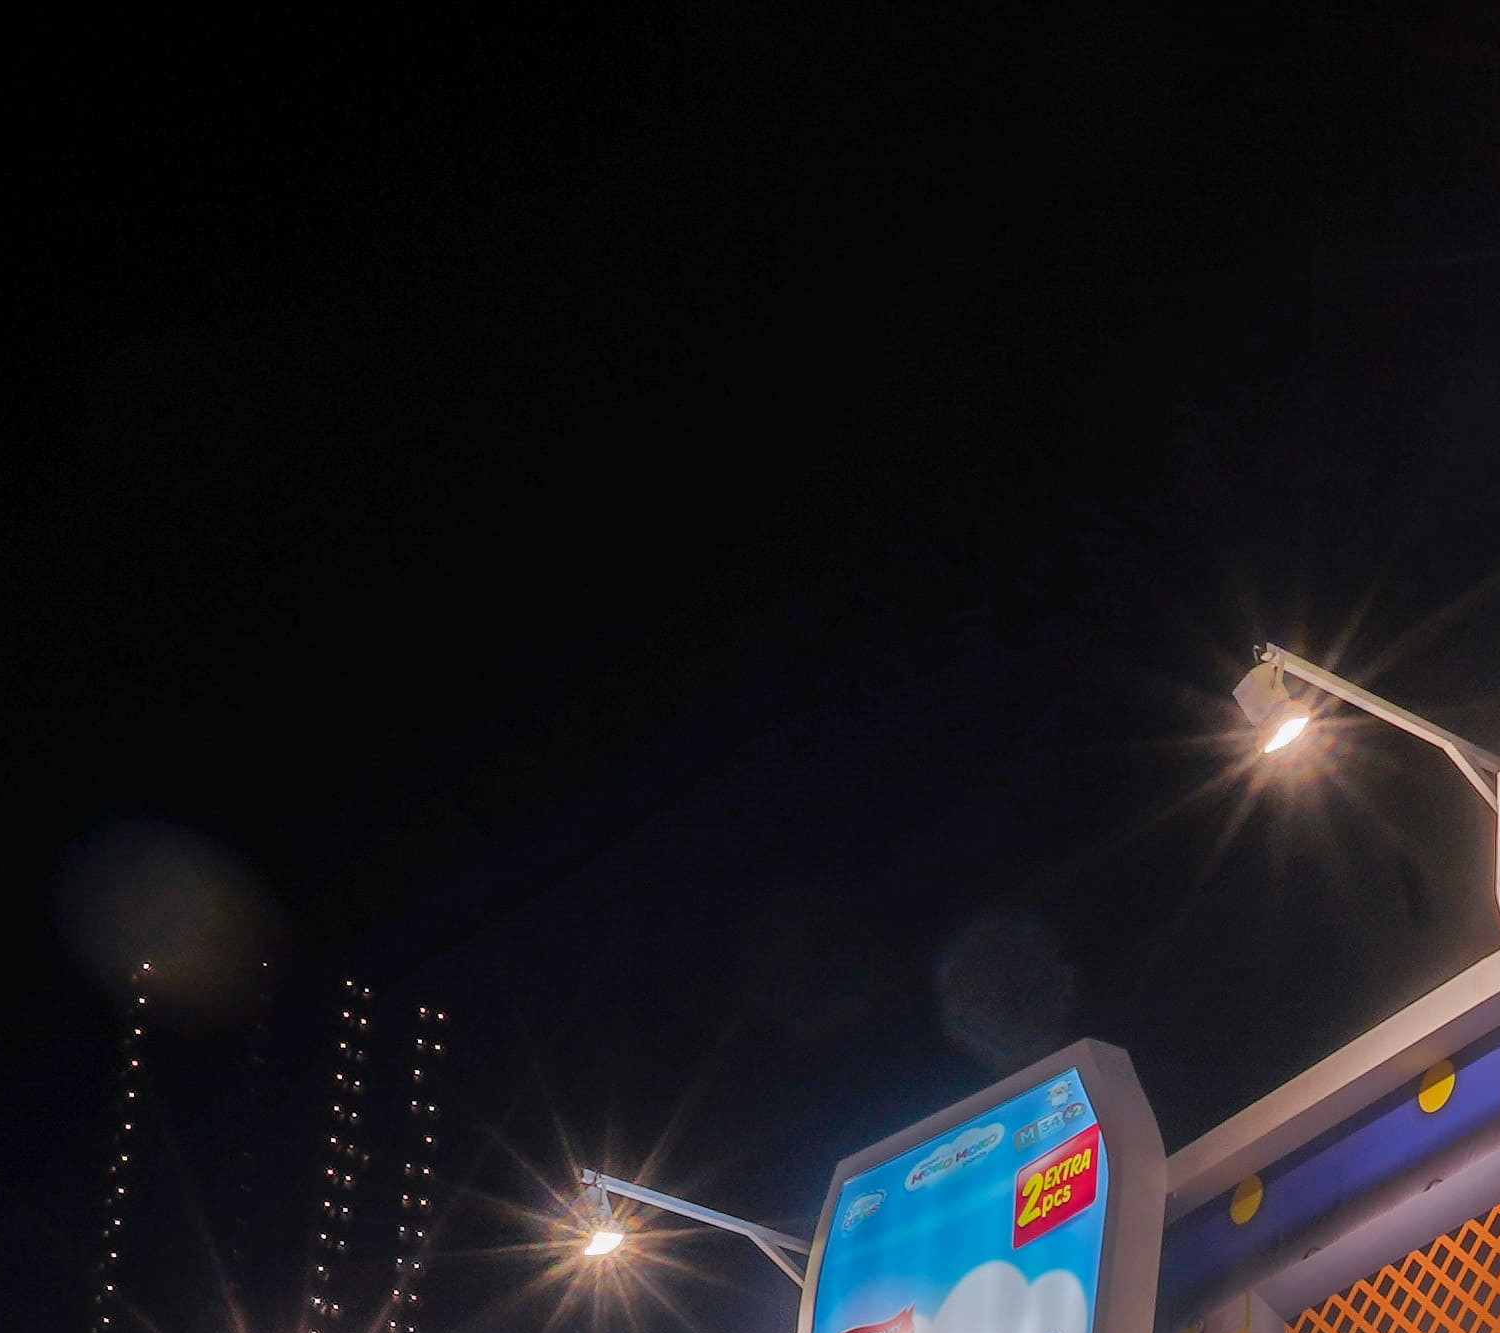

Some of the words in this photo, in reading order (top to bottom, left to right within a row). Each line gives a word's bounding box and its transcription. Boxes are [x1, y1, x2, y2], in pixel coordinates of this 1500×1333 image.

[1042, 1147, 1092, 1190] EXTRA
[1016, 1172, 1043, 1228] 2
[1041, 1184, 1072, 1218] pcs
